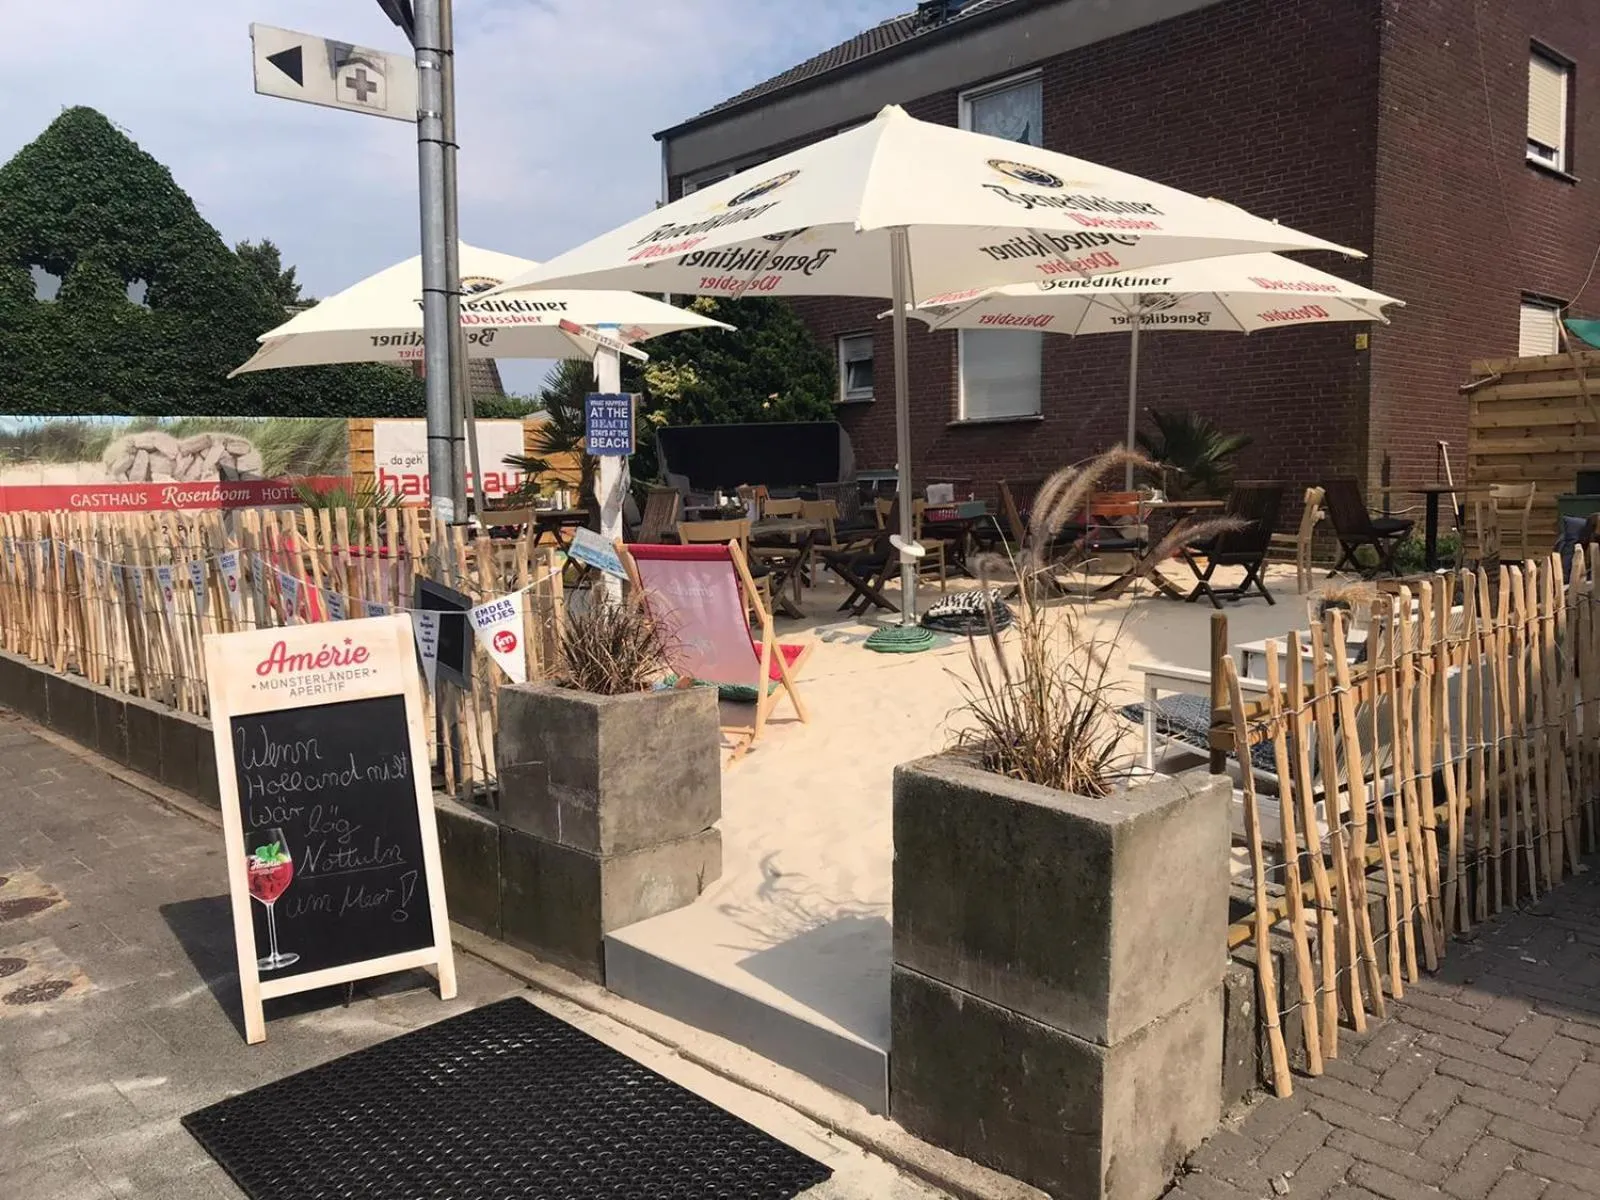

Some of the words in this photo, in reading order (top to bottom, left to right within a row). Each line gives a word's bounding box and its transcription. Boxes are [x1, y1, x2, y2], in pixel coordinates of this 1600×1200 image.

[590, 407, 604, 418] AT
[606, 407, 629, 418] THE
[590, 418, 629, 429] BEACH
[590, 437, 630, 448] BEACH
[390, 456, 403, 466] da
[70, 492, 148, 508] GASTHAUS
[161, 485, 251, 508] Rosenboom
[474, 600, 511, 619] EMDER
[478, 607, 515, 628] MATJES
[256, 637, 370, 676] Amérie
[289, 681, 345, 698] APERITIF
[236, 724, 323, 770] Wenn
[247, 752, 363, 799] Holland
[250, 797, 305, 828] wär
